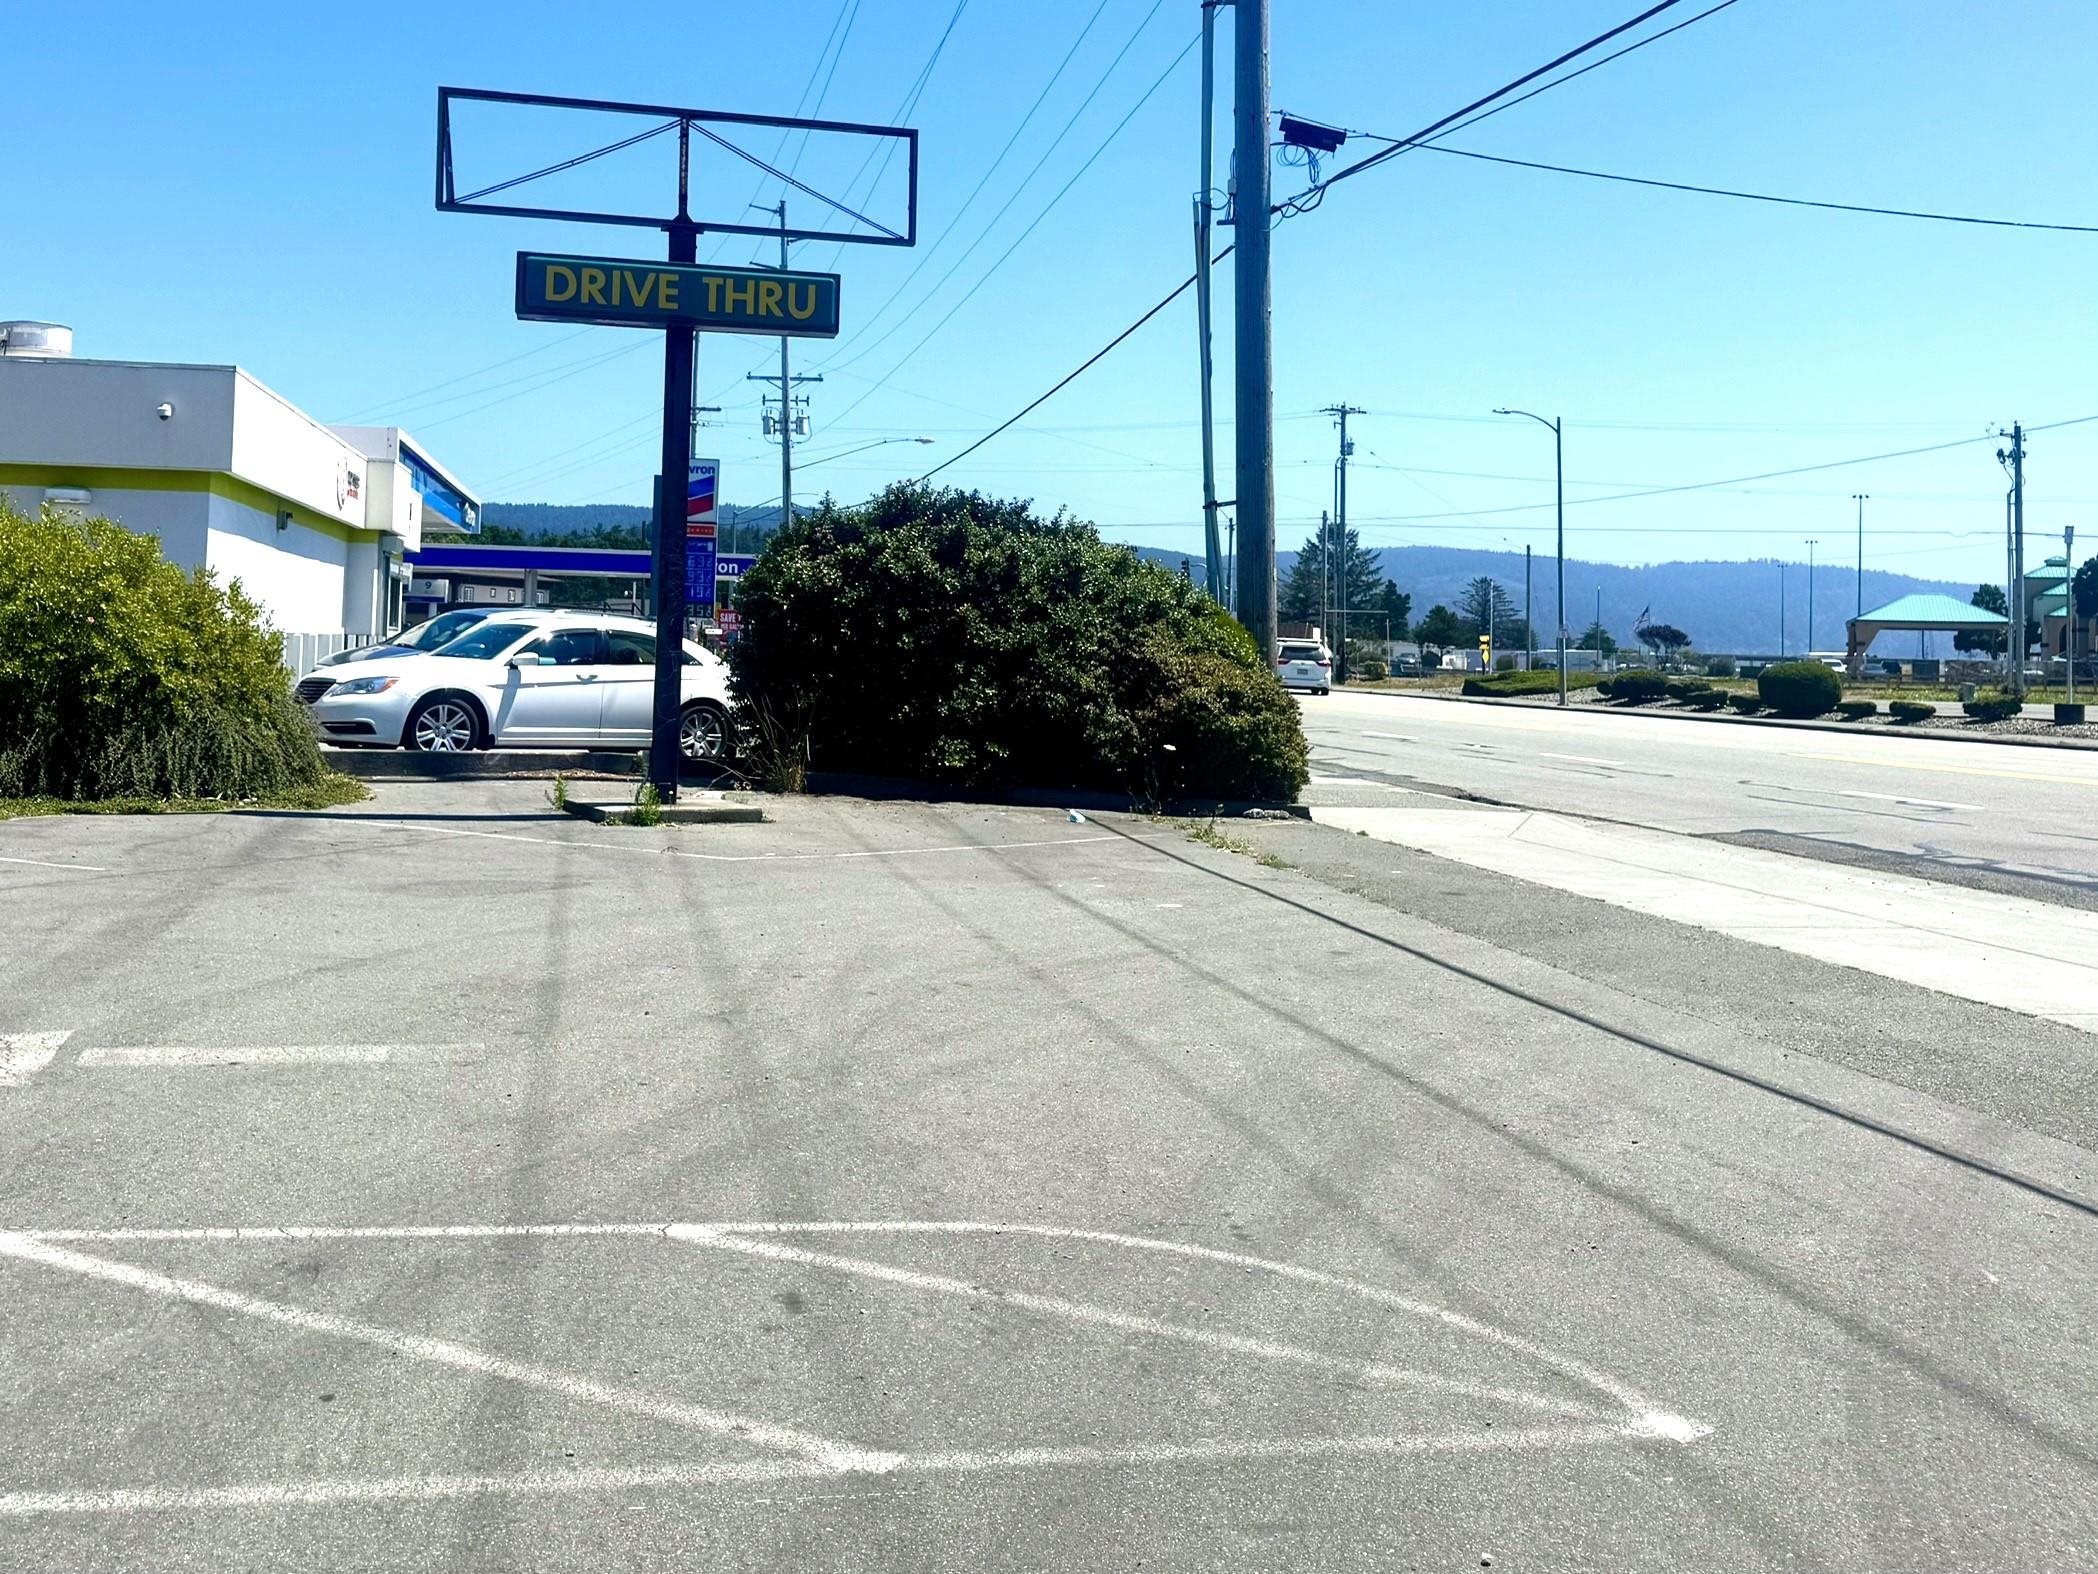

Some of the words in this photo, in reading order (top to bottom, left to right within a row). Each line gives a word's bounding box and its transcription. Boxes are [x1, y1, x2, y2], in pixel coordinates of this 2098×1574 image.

[545, 265, 679, 310] DRIVE
[702, 276, 817, 320] THRU
[689, 465, 715, 475] vron
[717, 562, 739, 574] on
[720, 612, 736, 623] SAVE
